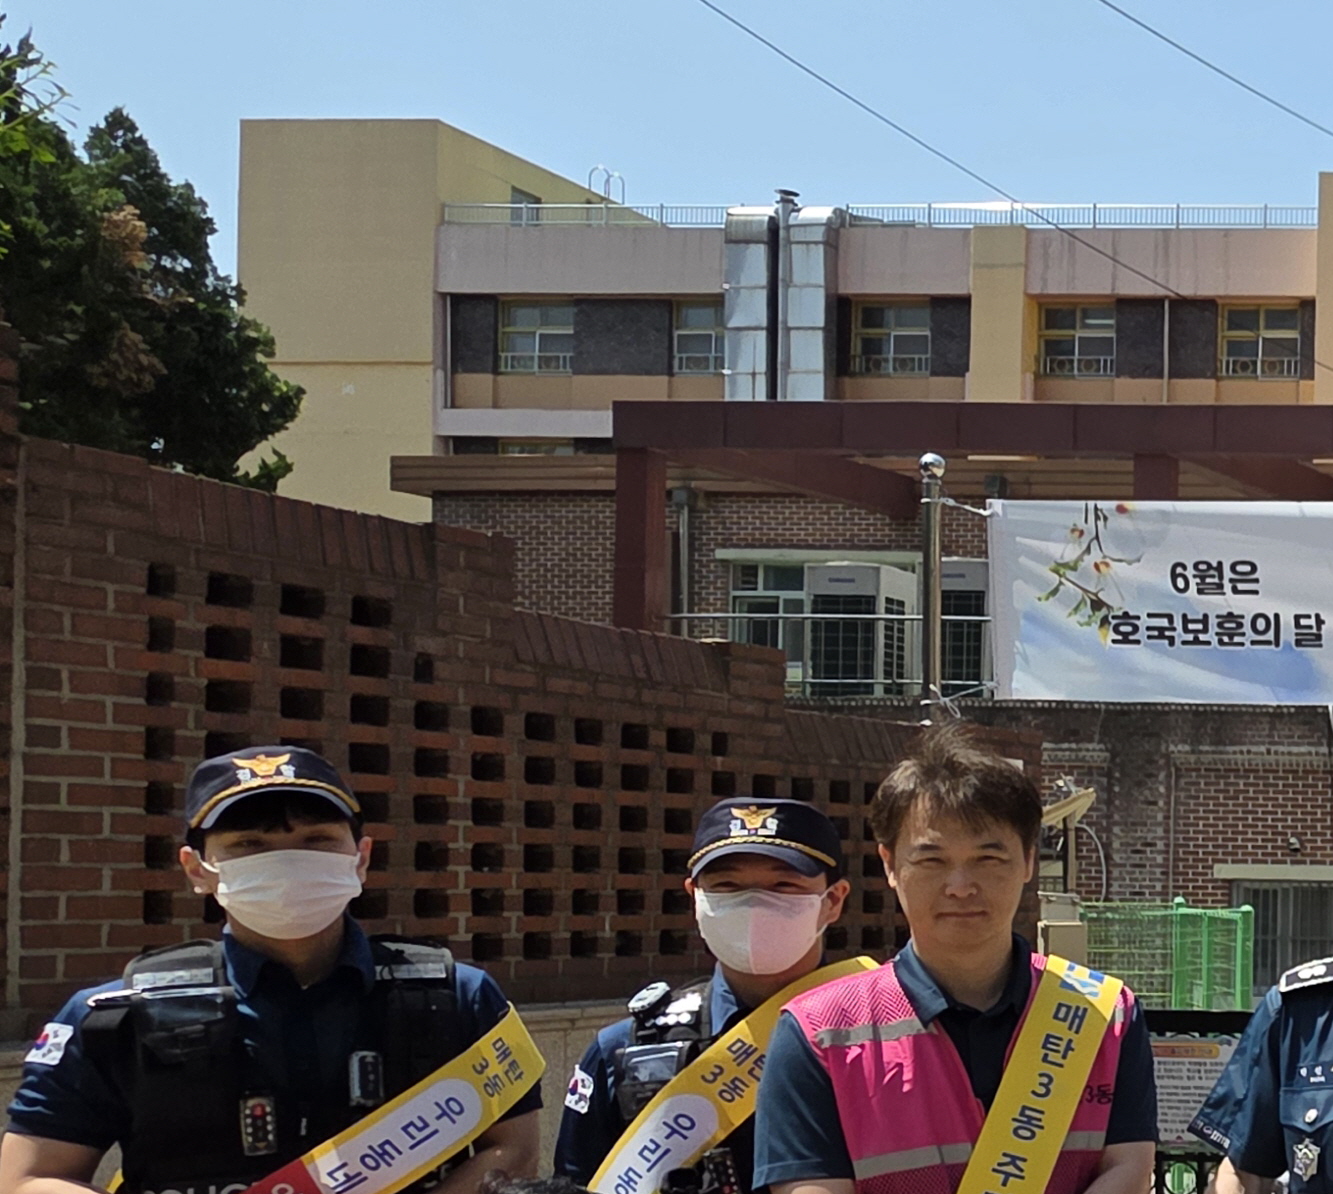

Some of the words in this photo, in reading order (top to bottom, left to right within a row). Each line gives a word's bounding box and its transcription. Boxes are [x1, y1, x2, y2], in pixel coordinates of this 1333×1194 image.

[1169, 559, 1261, 596] 6월은
[1110, 610, 1283, 650] 호국보훈의
[1293, 611, 1326, 649] 달
[471, 1056, 504, 1098] 3동
[491, 1036, 524, 1090] 매탄
[1011, 1001, 1089, 1142] 매탄3동
[701, 1065, 746, 1104] 3동
